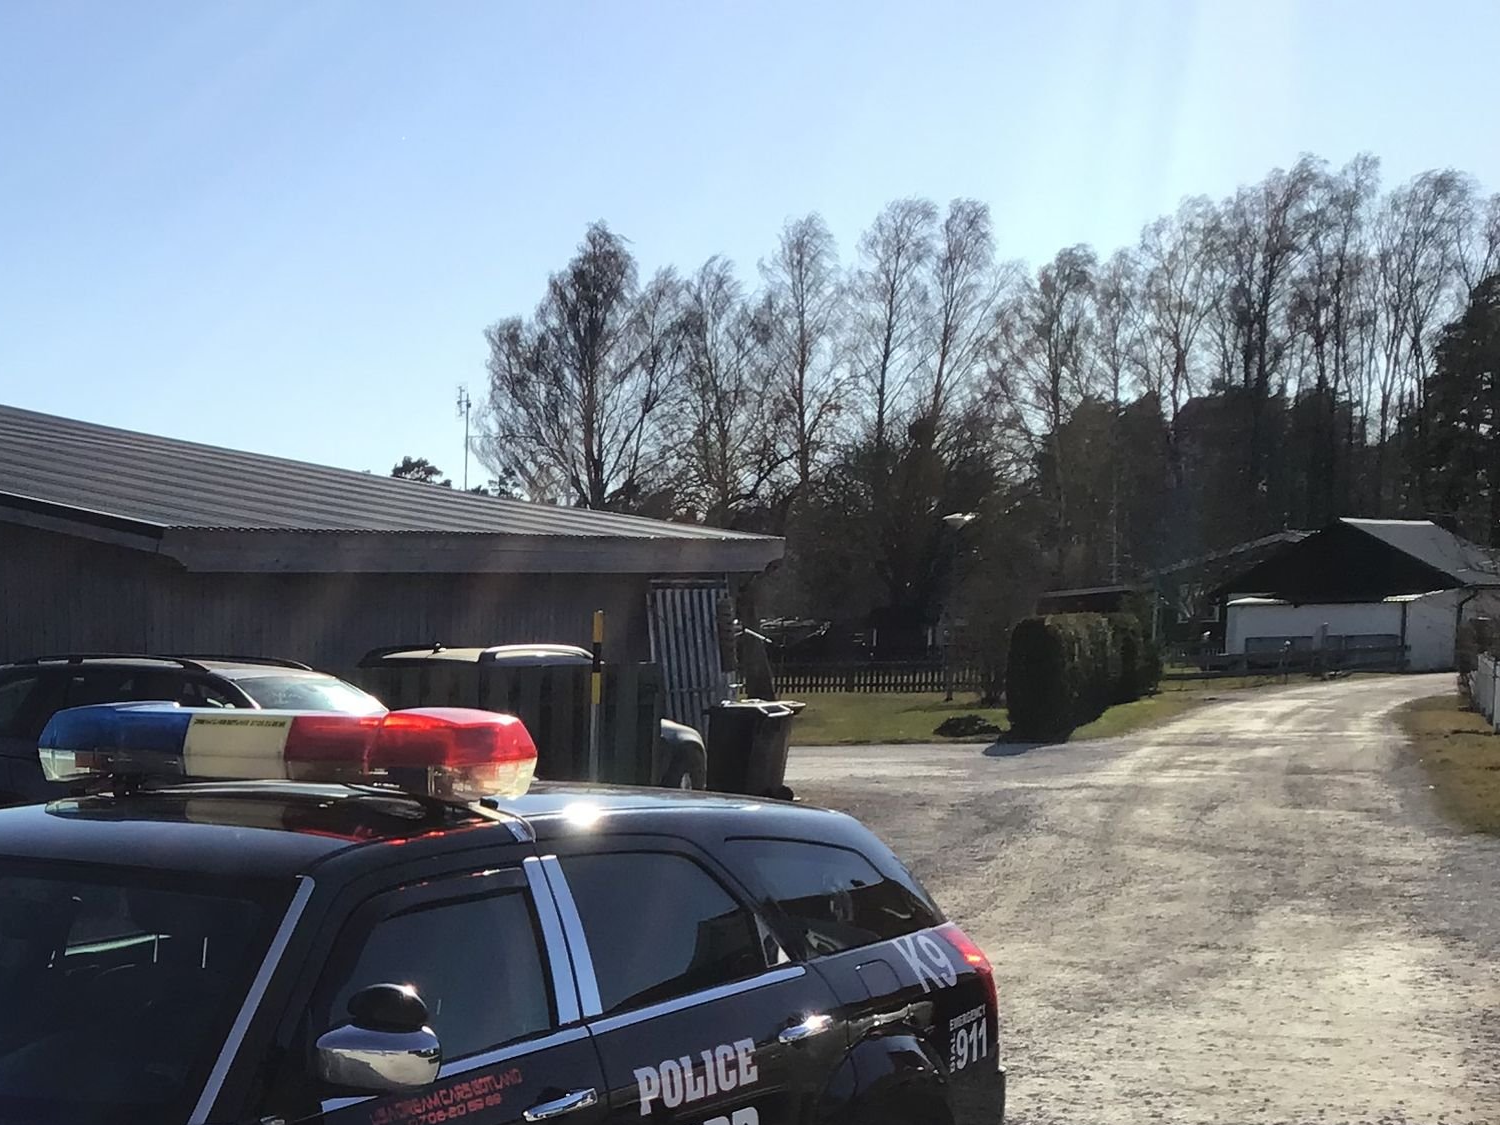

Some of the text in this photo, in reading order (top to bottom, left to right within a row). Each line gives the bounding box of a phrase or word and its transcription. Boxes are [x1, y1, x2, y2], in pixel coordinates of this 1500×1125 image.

[891, 934, 958, 994] K9
[956, 1017, 987, 1070] 911
[439, 1083, 473, 1105] CARS
[633, 1037, 759, 1116] POLICE
